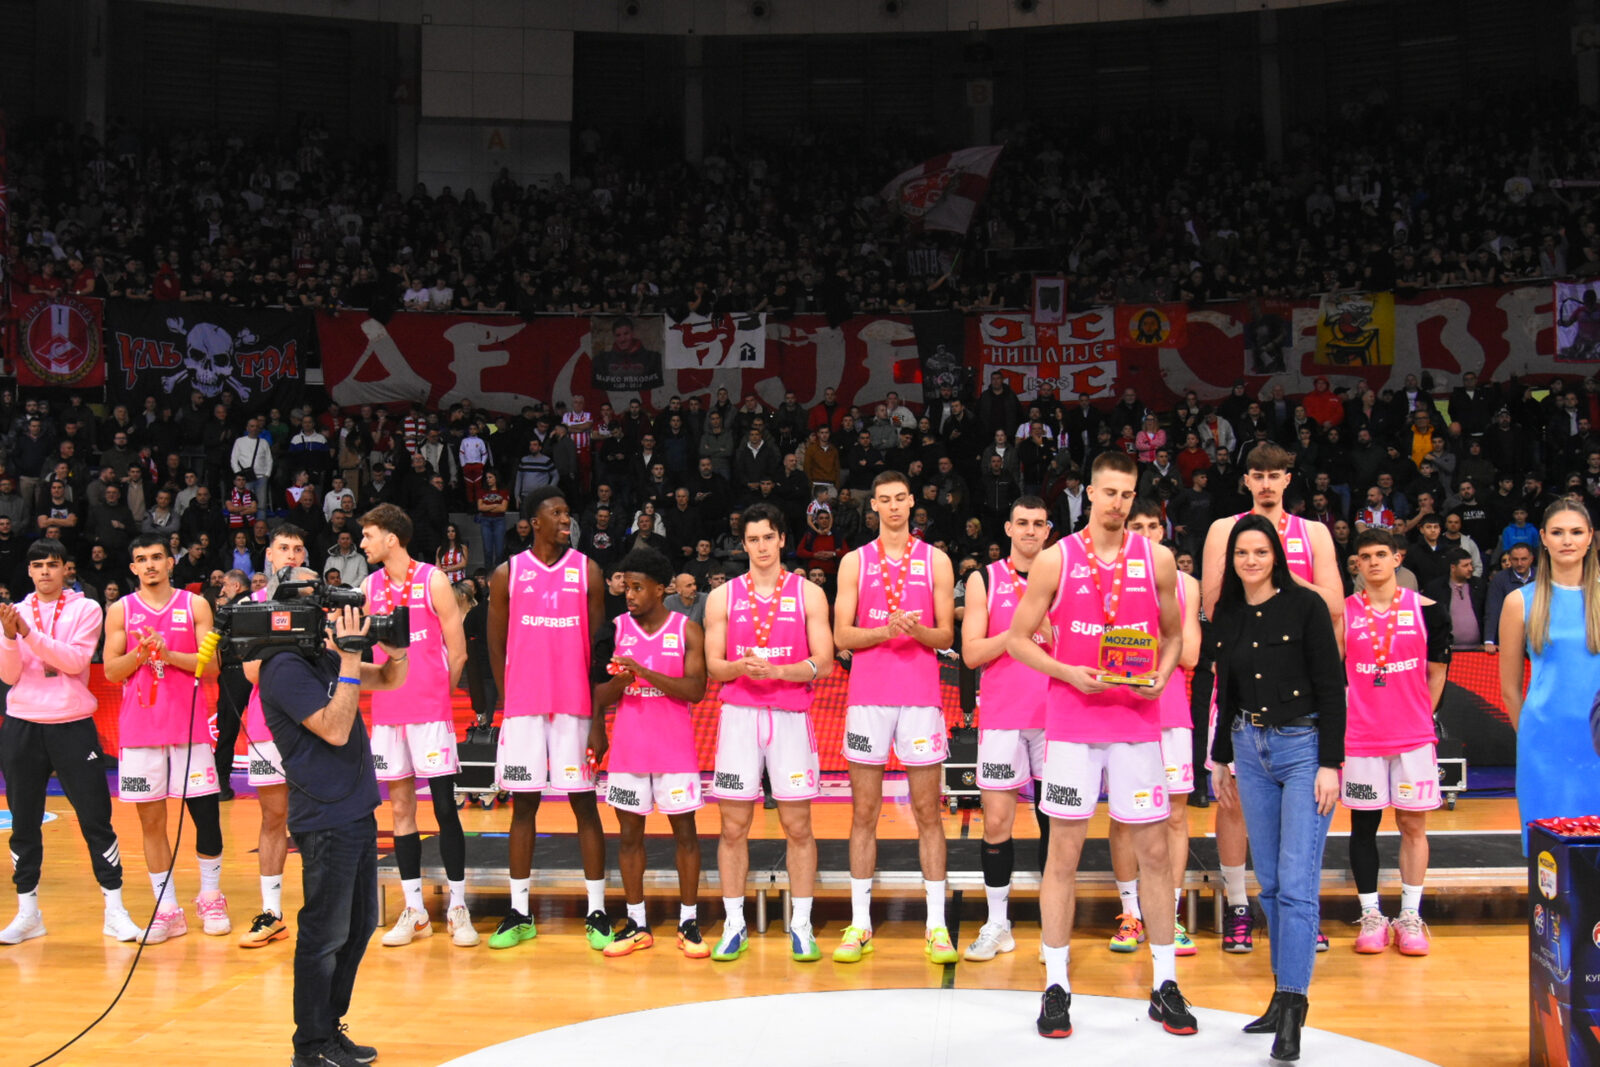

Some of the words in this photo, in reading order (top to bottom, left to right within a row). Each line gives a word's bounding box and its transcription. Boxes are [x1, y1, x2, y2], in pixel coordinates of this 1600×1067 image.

[487, 130, 505, 150] A
[541, 591, 559, 609] 11
[521, 614, 580, 628] SUPERBET
[1104, 635, 1153, 647] MOZZART
[440, 747, 451, 765] 7
[205, 766, 217, 784] 5
[982, 762, 1012, 771] FASHION
[806, 768, 815, 788] 3
[611, 785, 637, 798] FASHION
[687, 781, 696, 800] 1
[1152, 785, 1164, 807] 6
[1415, 780, 1434, 800] 77
